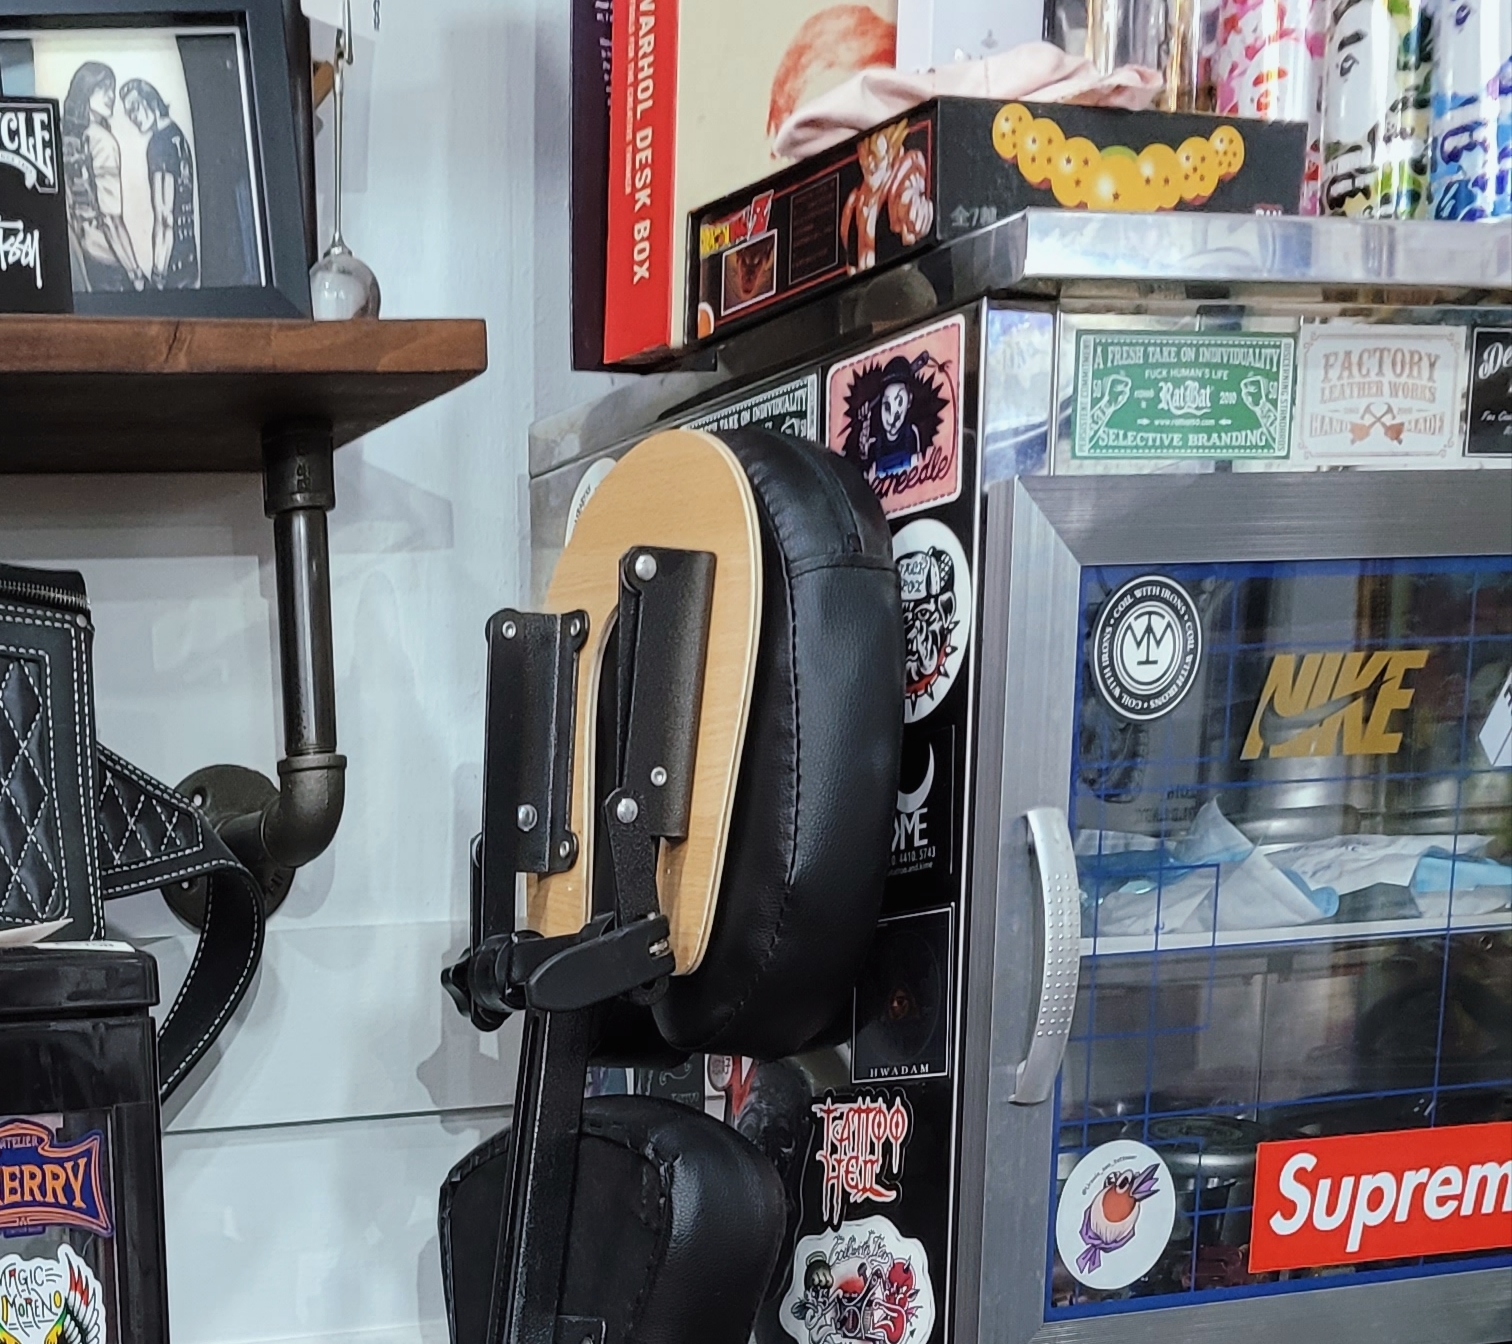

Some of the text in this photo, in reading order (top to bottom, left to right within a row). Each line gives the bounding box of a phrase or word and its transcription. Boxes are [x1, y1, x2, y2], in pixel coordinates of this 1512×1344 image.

[633, 129, 654, 213] DESK
[632, 223, 651, 285] BOX
[1094, 345, 1281, 372] A FRESH TAKE ON INDIVIDUALITY
[1144, 368, 1168, 380] FUCK
[1212, 370, 1230, 381] LIFE
[1321, 347, 1441, 384] FACTORY
[752, 387, 808, 424] INDIVIDUALITY
[1319, 380, 1437, 405] LEATHER WORKS
[1099, 427, 1267, 447] SELECTIVE BRANDING
[1113, 585, 1187, 618] COIL WITH IRONS
[1240, 650, 1430, 760] NIKE
[869, 1062, 931, 1079] HWADAM
[811, 1096, 911, 1175] TATTOO
[1269, 1152, 1512, 1253] Suprem
